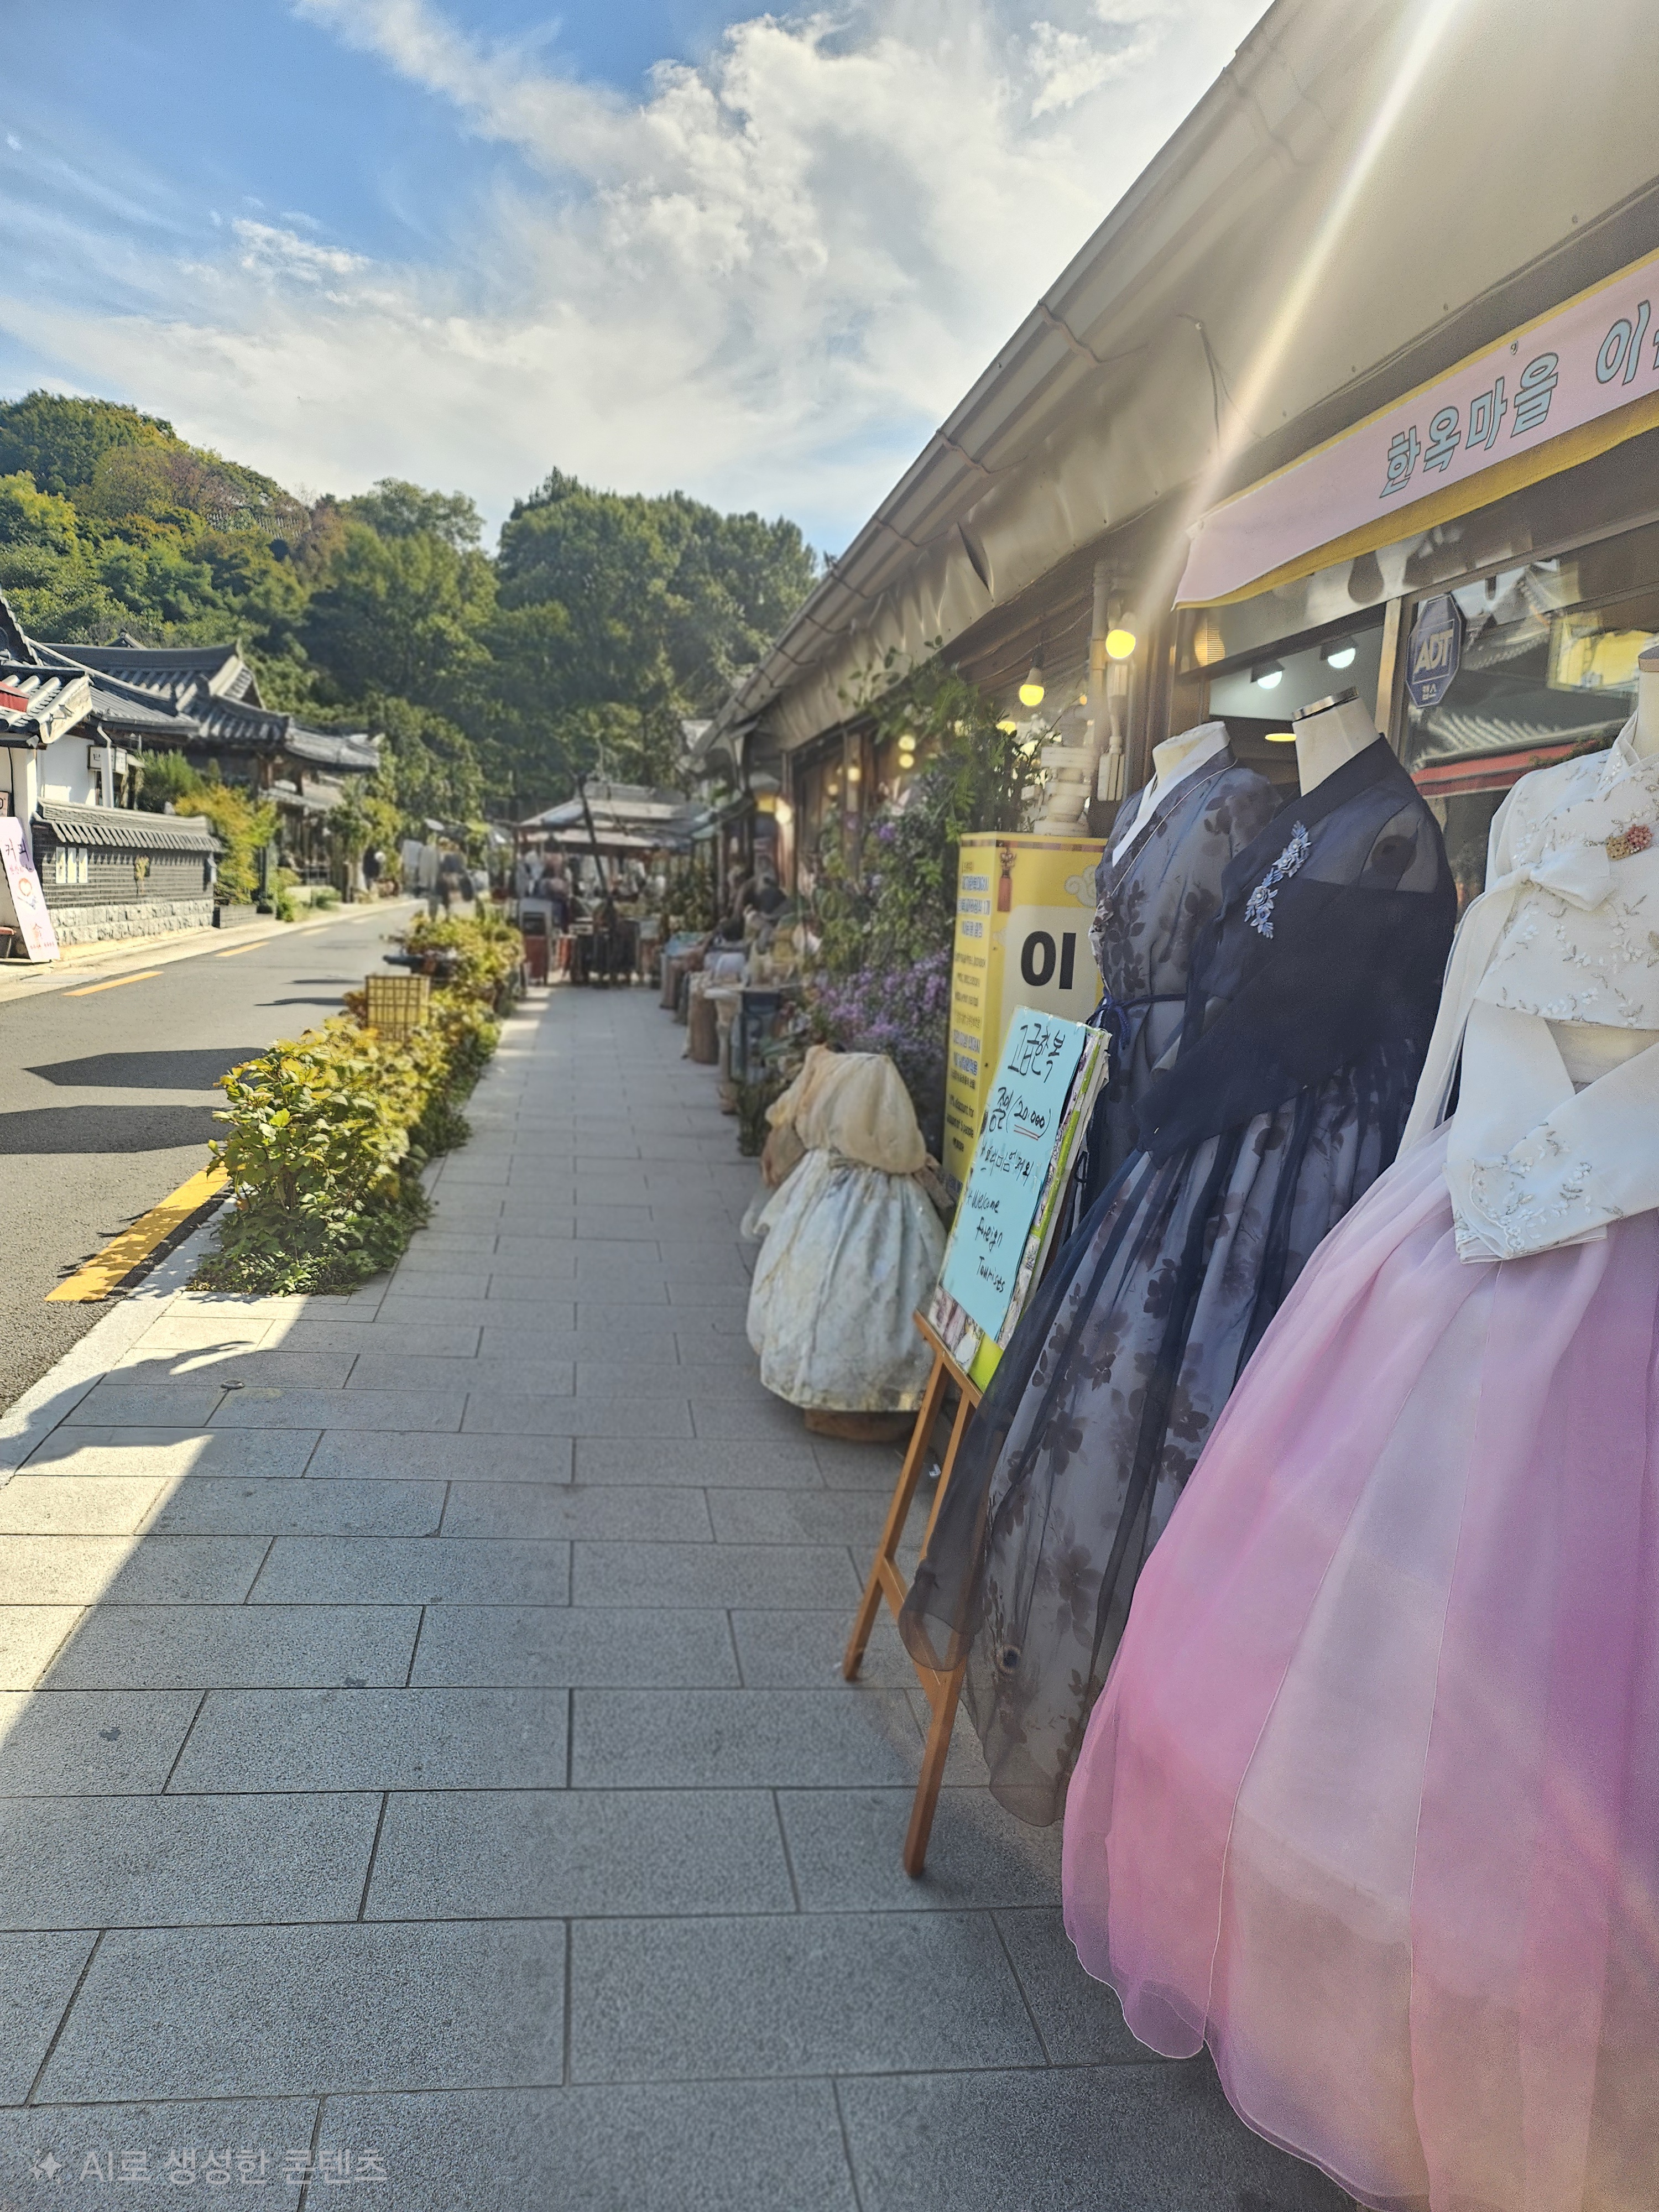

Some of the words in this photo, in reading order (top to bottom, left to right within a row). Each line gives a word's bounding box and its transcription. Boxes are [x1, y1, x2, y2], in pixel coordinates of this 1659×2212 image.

[1380, 352, 1559, 498] 한옥마을
[1596, 299, 1659, 387] 이
[1413, 629, 1453, 676] ADT
